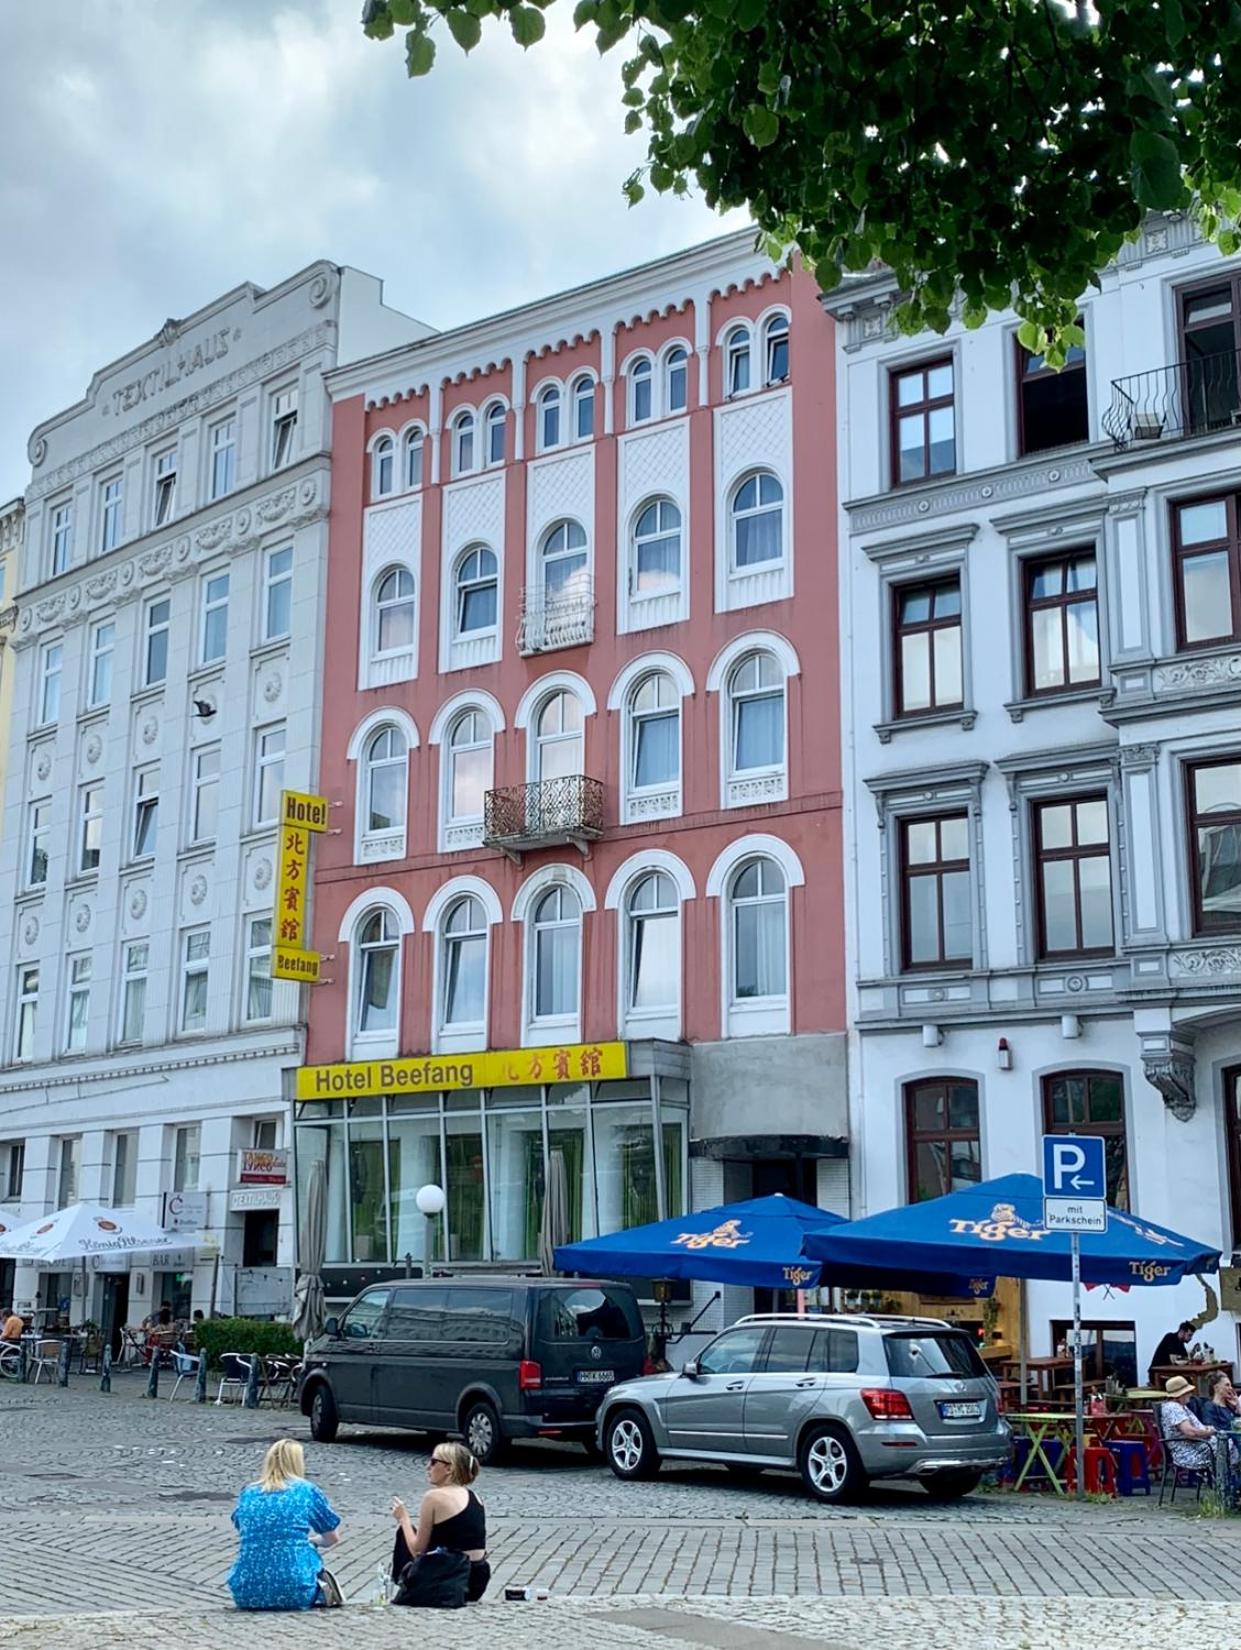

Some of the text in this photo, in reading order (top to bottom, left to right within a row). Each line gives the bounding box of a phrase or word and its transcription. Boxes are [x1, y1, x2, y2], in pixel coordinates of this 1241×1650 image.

[286, 796, 326, 825] Hotel
[281, 832, 305, 942] 北方賓館
[277, 954, 319, 976] Beefang
[316, 1061, 473, 1091] Hotel Beefang
[1053, 1144, 1085, 1189] P
[1050, 1213, 1102, 1227] Parkschein
[1067, 1204, 1083, 1214] mit
[671, 1231, 750, 1250] Tiger
[949, 1218, 1051, 1242] Tiger
[782, 1265, 813, 1286] Tiger
[1129, 1261, 1171, 1283] Tiger
[968, 1278, 990, 1296] Tiger
